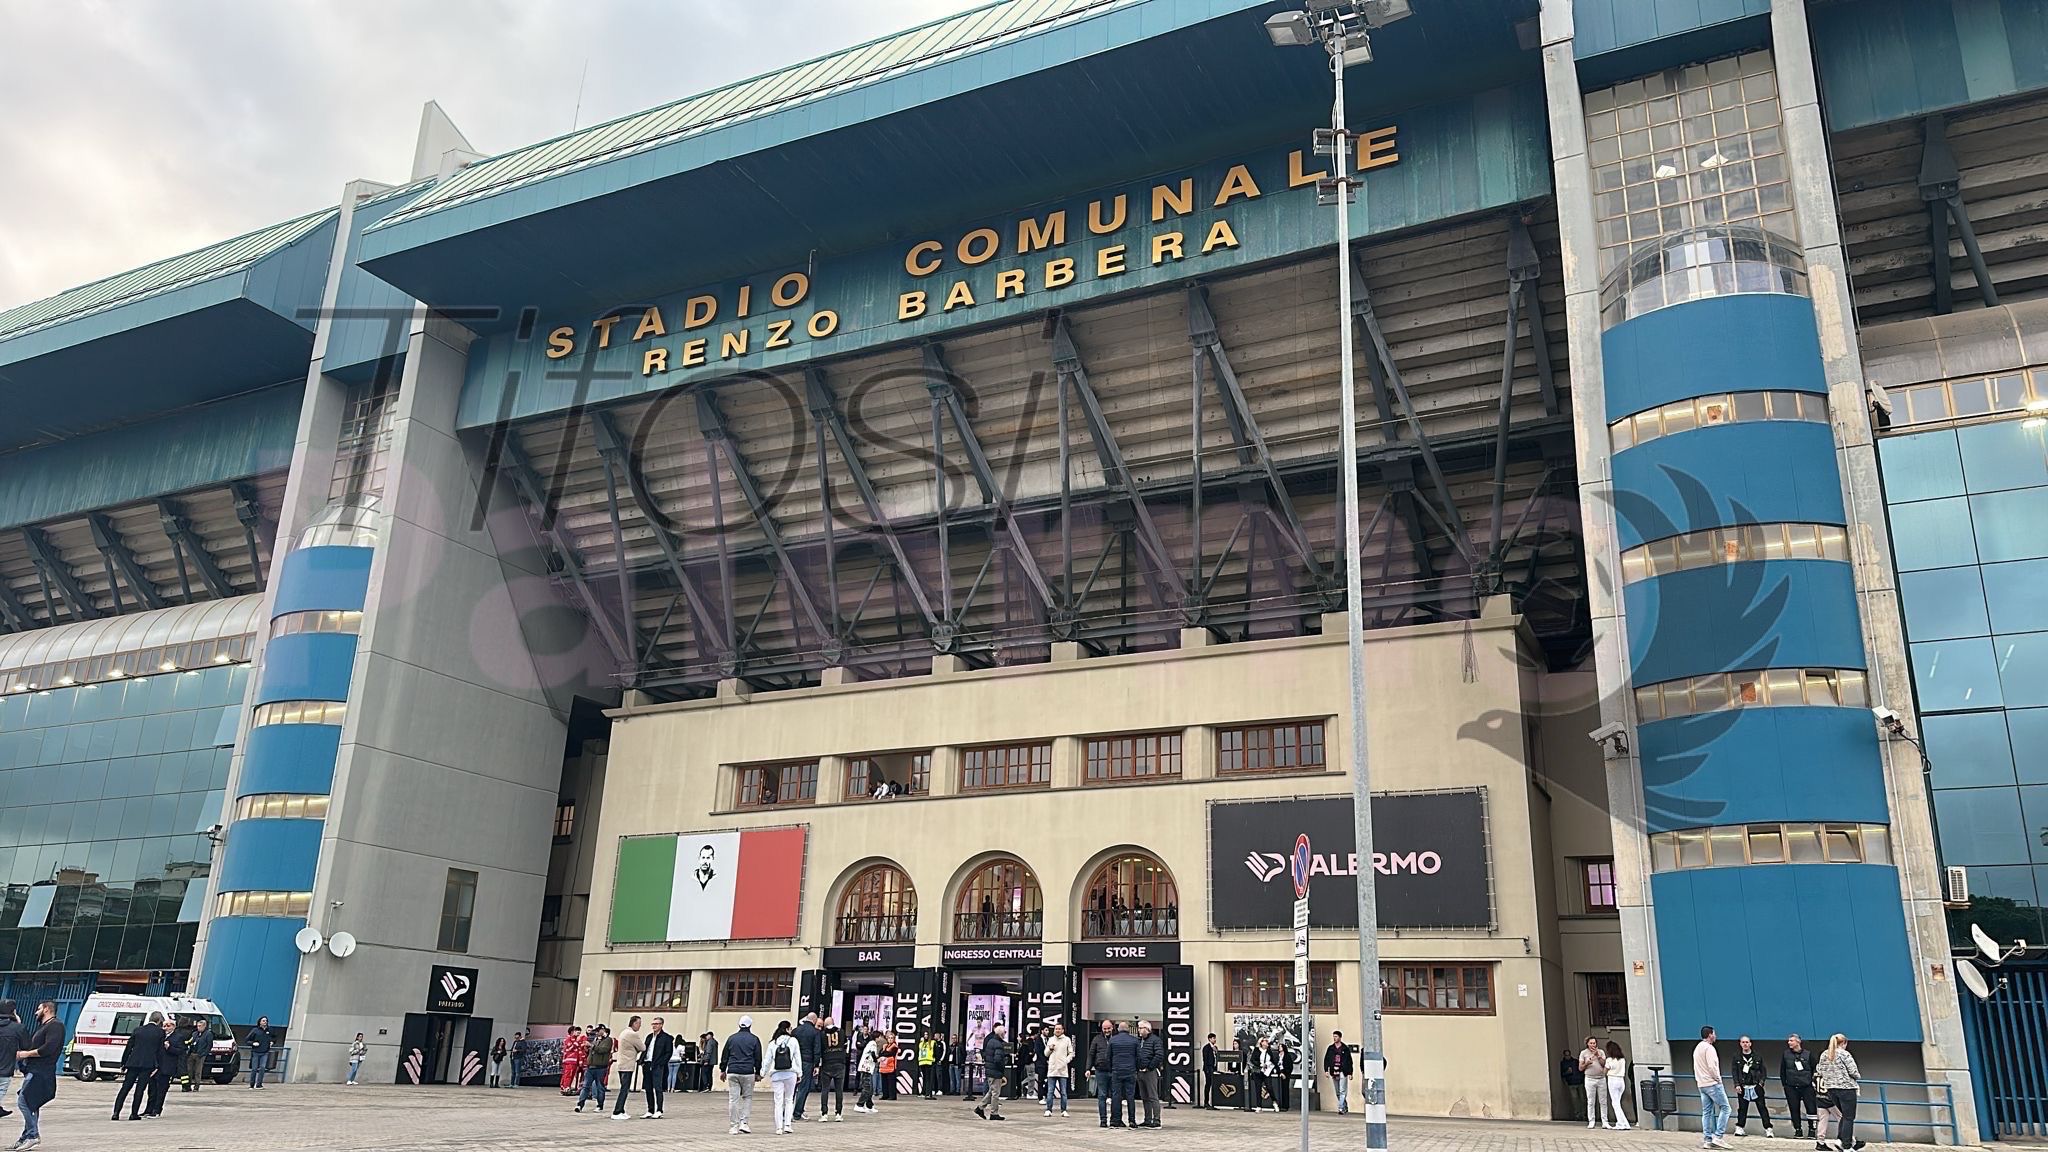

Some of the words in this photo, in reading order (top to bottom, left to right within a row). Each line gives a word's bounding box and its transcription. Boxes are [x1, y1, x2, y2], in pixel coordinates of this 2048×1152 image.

[546, 272, 810, 360] STADIO
[904, 124, 1400, 278] COMUNALE
[642, 309, 839, 376] RENZO
[898, 219, 1240, 321] BARBERA
[858, 951, 881, 962] BAR
[944, 950, 991, 959] INGRESSO
[993, 949, 1042, 959] CENTRALE
[1105, 946, 1147, 958] STORE
[896, 993, 918, 1061] STORE
[922, 993, 932, 1028] AR
[1043, 991, 1063, 1029] AR
[826, 1031, 839, 1047] 19
[1168, 991, 1190, 1066] STORE
